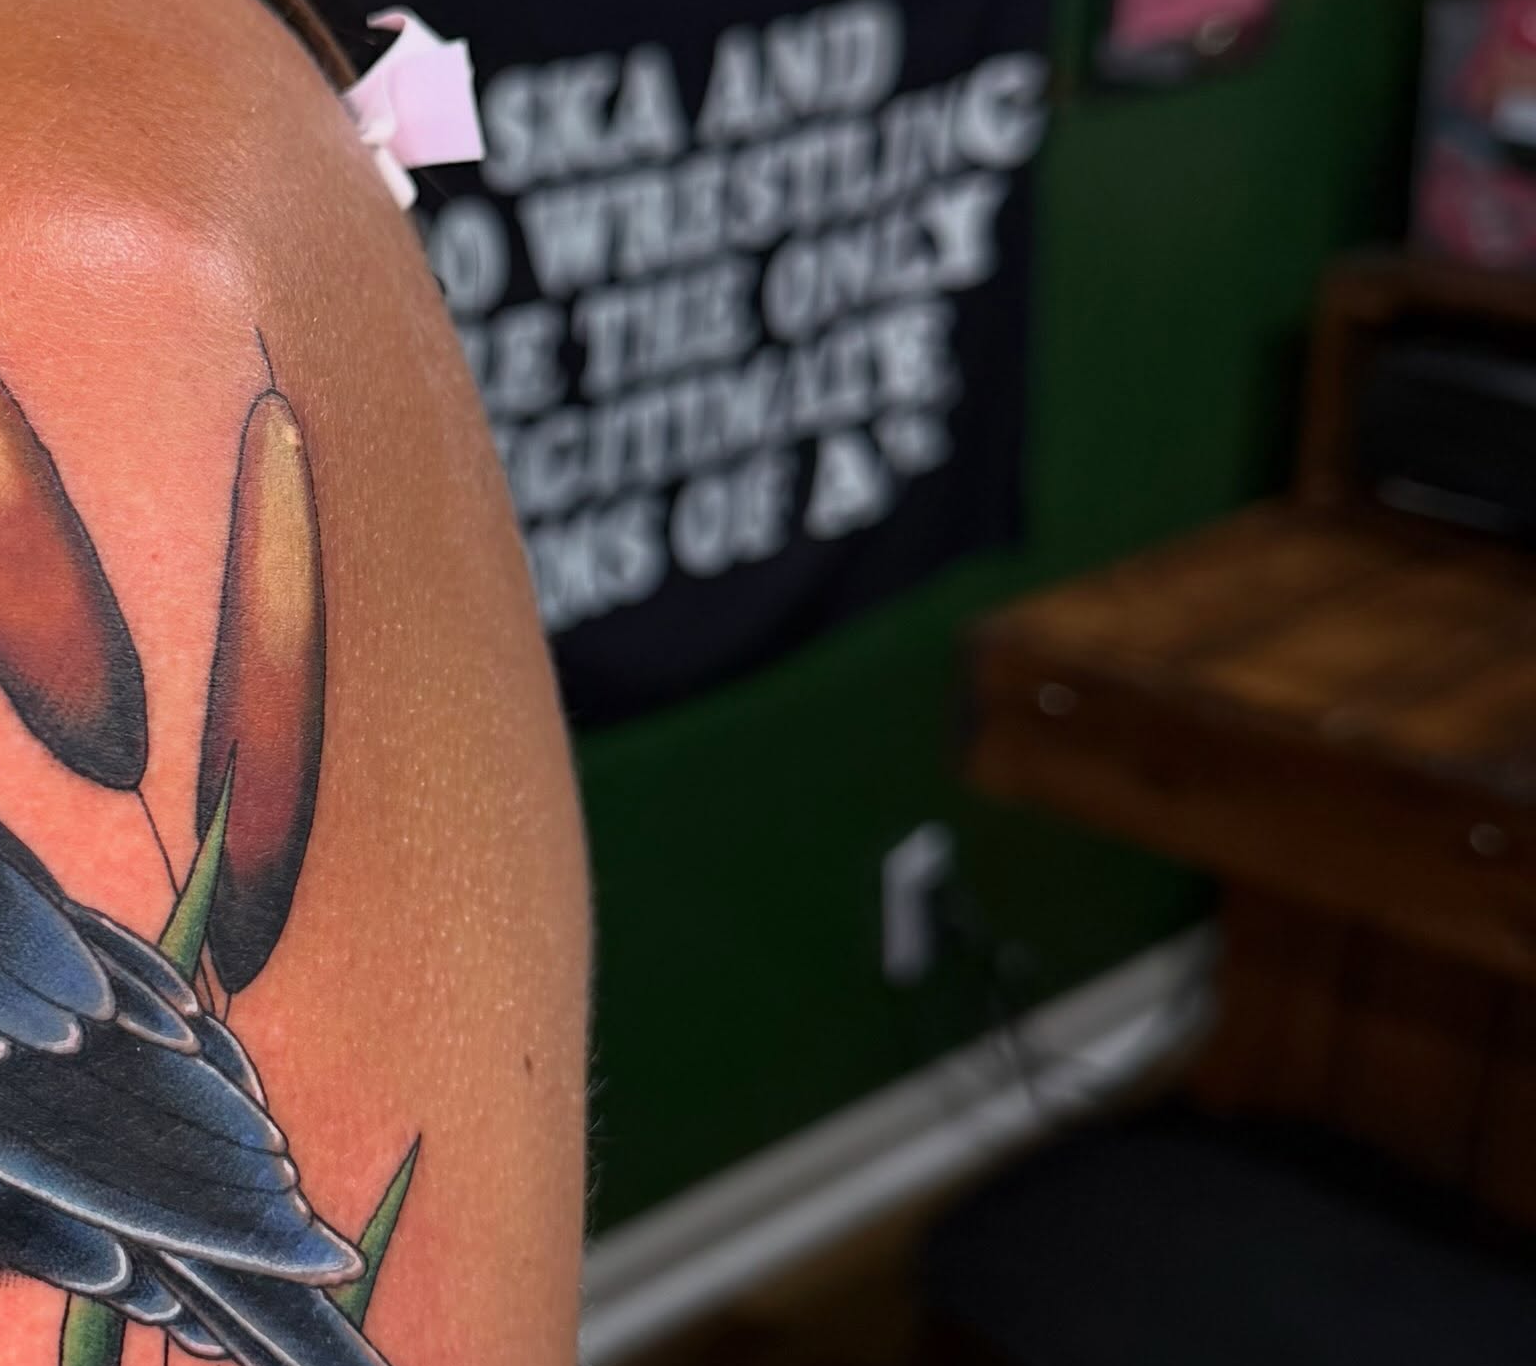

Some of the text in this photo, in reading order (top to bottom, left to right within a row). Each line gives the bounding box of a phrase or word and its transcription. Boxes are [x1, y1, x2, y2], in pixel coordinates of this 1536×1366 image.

[481, 45, 686, 193] SKA
[519, 55, 1047, 295] WRESTLING
[572, 253, 756, 400] THE
[764, 175, 1009, 340] ONLY
[496, 305, 956, 511] GITIMATE
[669, 453, 797, 577] OF
